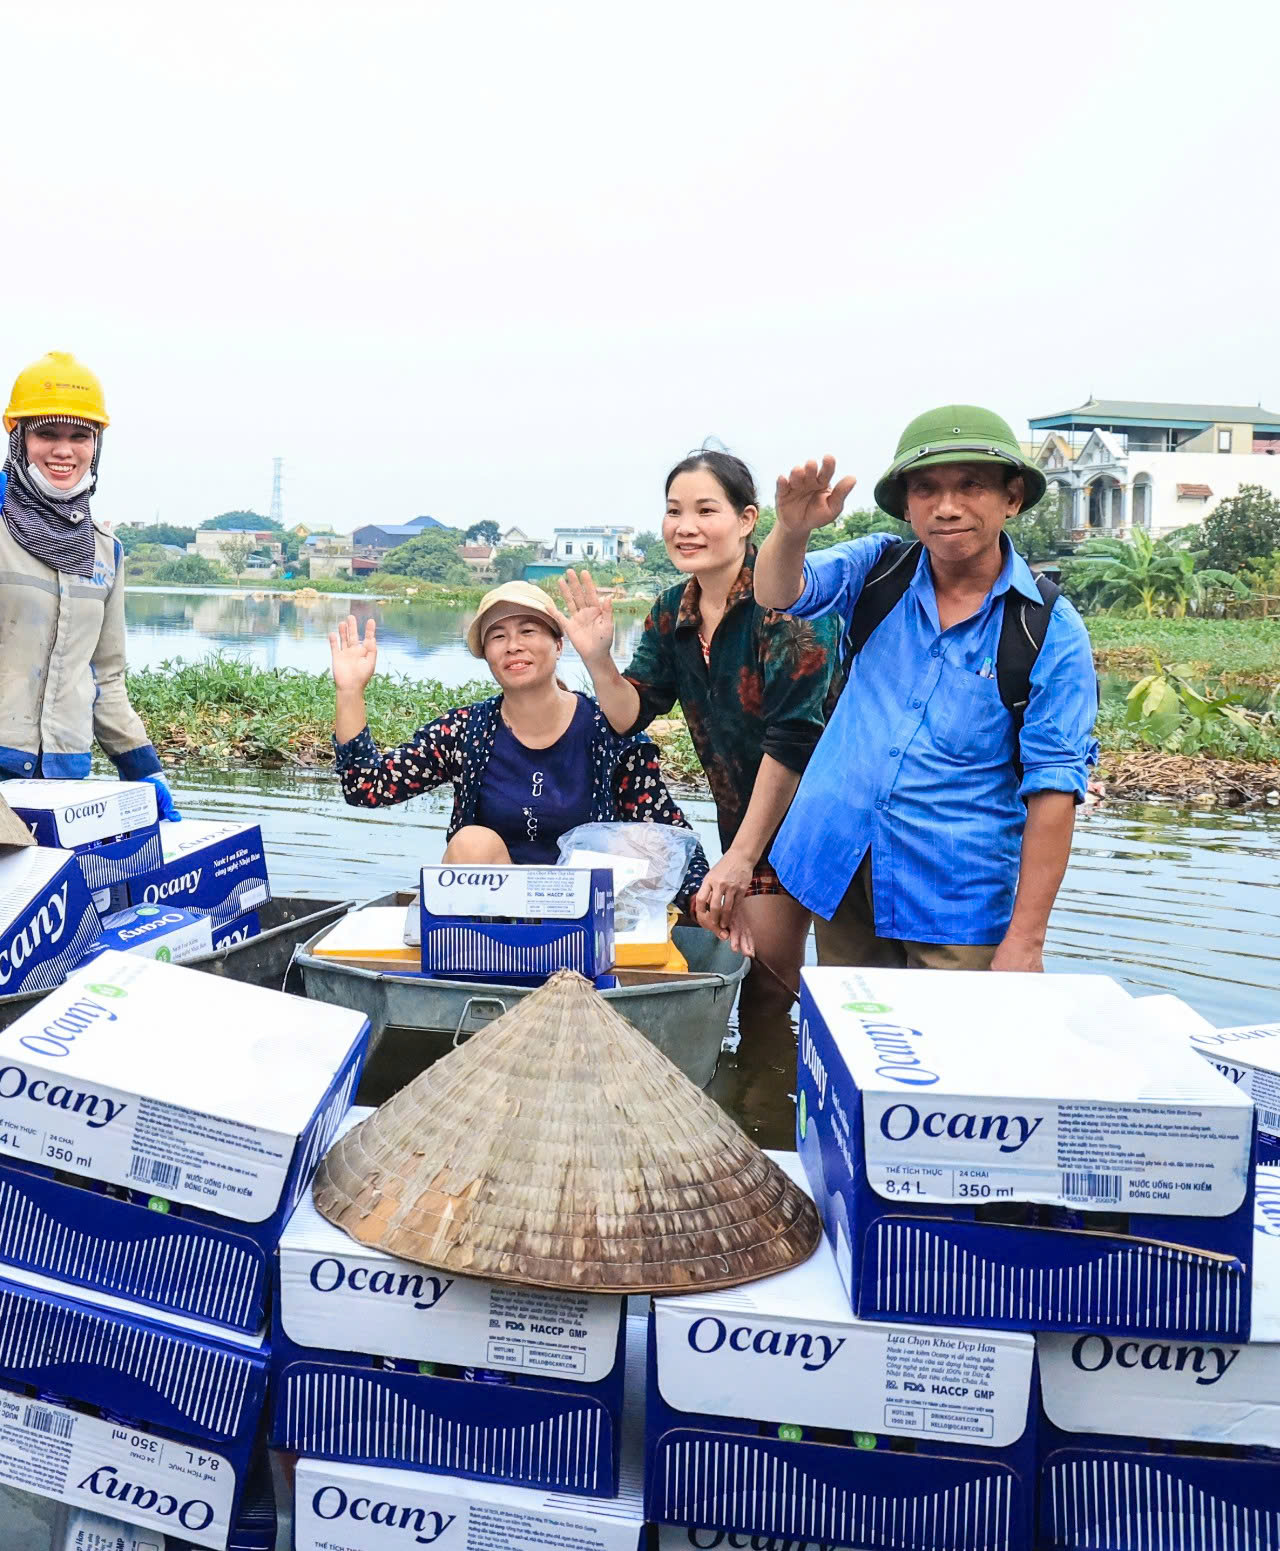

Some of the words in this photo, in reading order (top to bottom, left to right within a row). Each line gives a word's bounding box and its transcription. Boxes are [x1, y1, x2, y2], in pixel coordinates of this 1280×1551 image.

[65, 800, 108, 823] Ocany
[144, 868, 202, 904] Ocany
[438, 870, 509, 892] Ocany
[118, 913, 184, 942] Ocany
[19, 997, 117, 1057] Ocany
[859, 1019, 940, 1086] Ocany
[802, 1019, 827, 1111] Ocany
[880, 1104, 1044, 1153] Ocany
[12, 1136, 20, 1148] L
[58, 1137, 74, 1145] CHAI
[46, 1146, 73, 1163] 350
[76, 1157, 92, 1168] ml
[202, 1187, 218, 1196] CHAI
[885, 1180, 911, 1195] 8,4
[916, 1181, 926, 1195] L
[959, 1184, 990, 1197] 350
[996, 1186, 1014, 1197] ml
[1175, 1182, 1191, 1190] I-ON
[1152, 1191, 1170, 1200] CHAI
[310, 1258, 454, 1310] Ocany
[505, 1320, 525, 1331] FDA
[530, 1323, 564, 1336] HACCP
[569, 1328, 588, 1338] GMP
[688, 1316, 846, 1371] Ocany
[887, 1333, 905, 1344] Lựa
[907, 1335, 931, 1347] Chọn
[977, 1343, 996, 1354] Hơn
[931, 1351, 949, 1359] Ocany
[1072, 1334, 1240, 1385] Ocany
[903, 1382, 925, 1393] FDA
[931, 1384, 969, 1397] HACCP
[974, 1389, 995, 1400] GMP
[931, 1413, 979, 1423] DRINKOCANY.COM
[112, 1429, 127, 1440] ml
[931, 1422, 984, 1433] HELLO@OCANY.COM
[131, 1435, 158, 1453] 350
[130, 1451, 146, 1462] CHAI
[185, 1451, 193, 1464] L
[198, 1454, 220, 1471] 8,4
[77, 1465, 214, 1531] Ocany
[312, 1486, 456, 1544] Ocany
